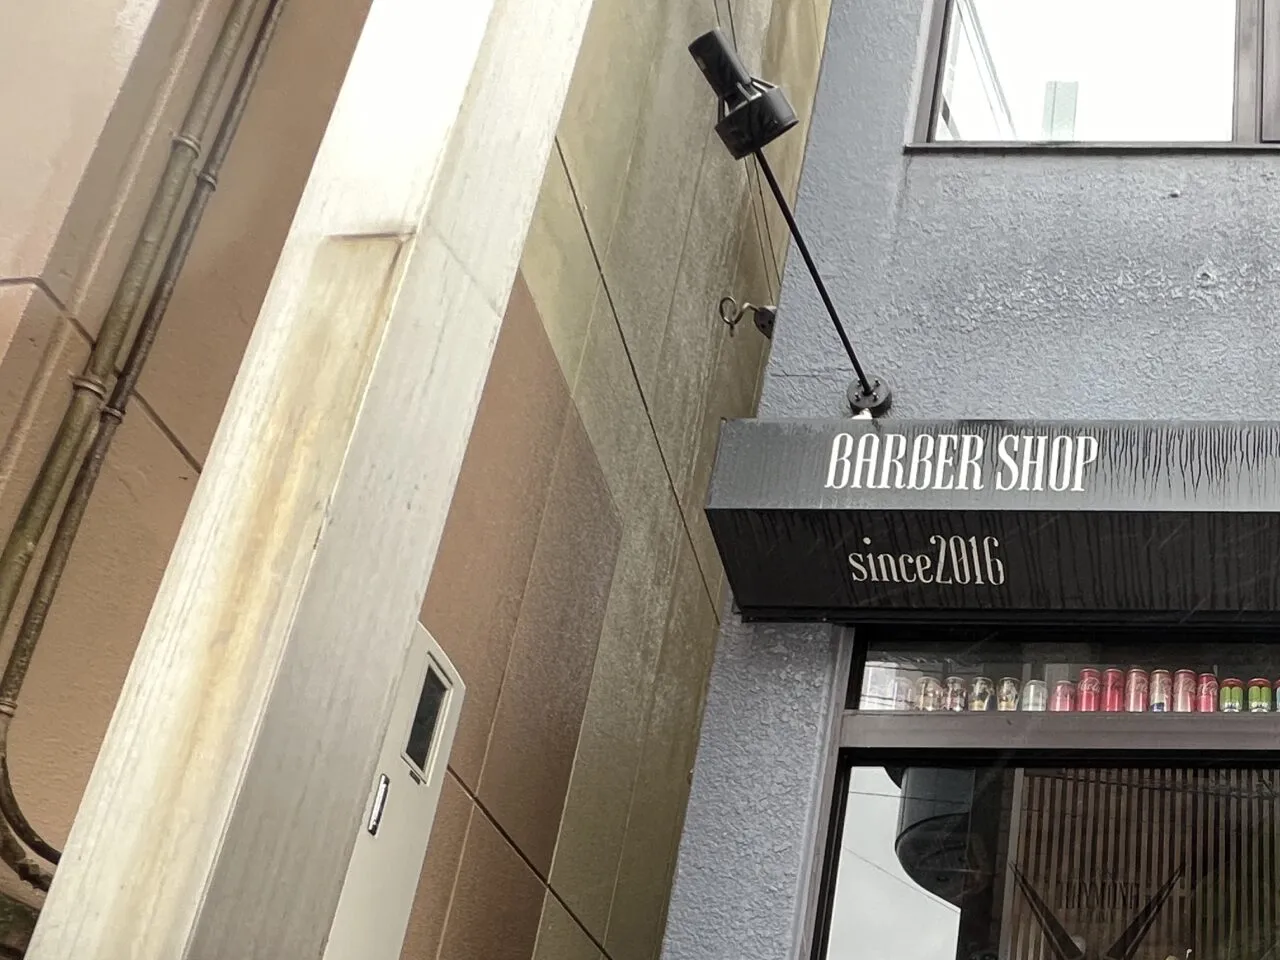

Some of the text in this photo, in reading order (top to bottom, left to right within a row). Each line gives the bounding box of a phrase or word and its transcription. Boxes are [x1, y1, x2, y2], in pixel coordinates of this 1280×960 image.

[824, 433, 1099, 492] BARBER SHOP
[848, 535, 1005, 586] since2016
